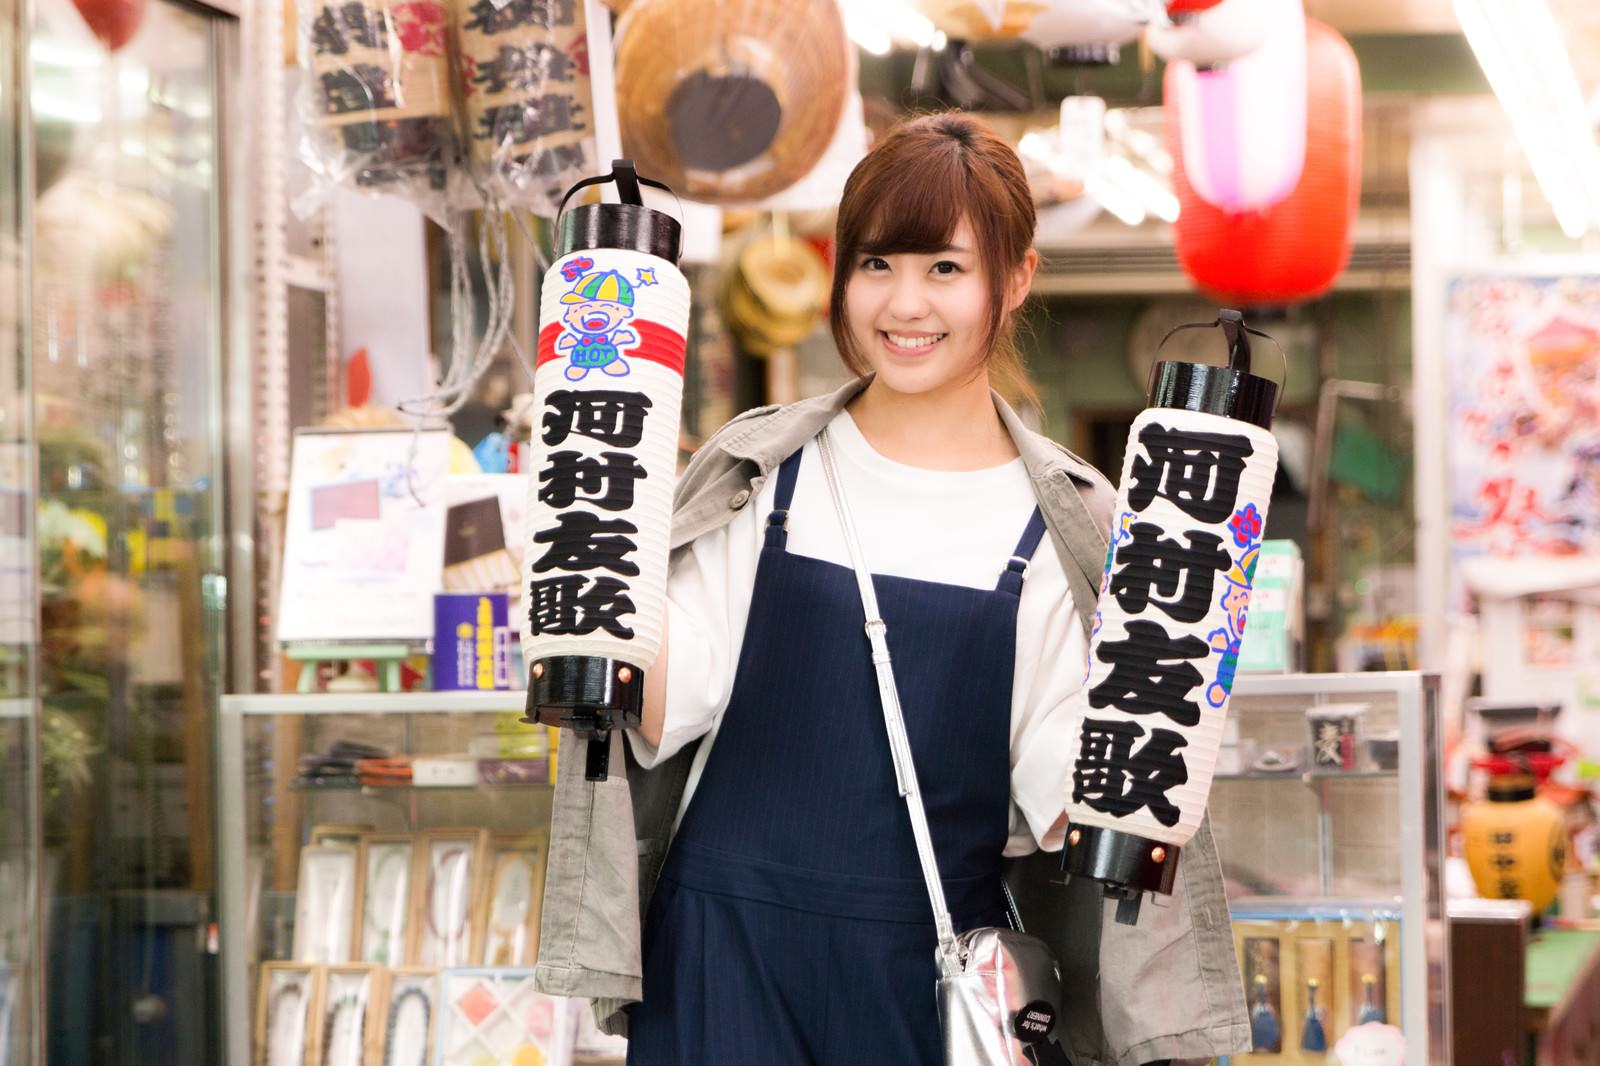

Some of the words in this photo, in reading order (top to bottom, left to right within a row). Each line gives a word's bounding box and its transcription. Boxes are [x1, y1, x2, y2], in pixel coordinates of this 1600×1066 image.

[575, 348, 612, 363] HOT
[1026, 1010, 1051, 1024] DINNER?
[1021, 1020, 1031, 1030] for
